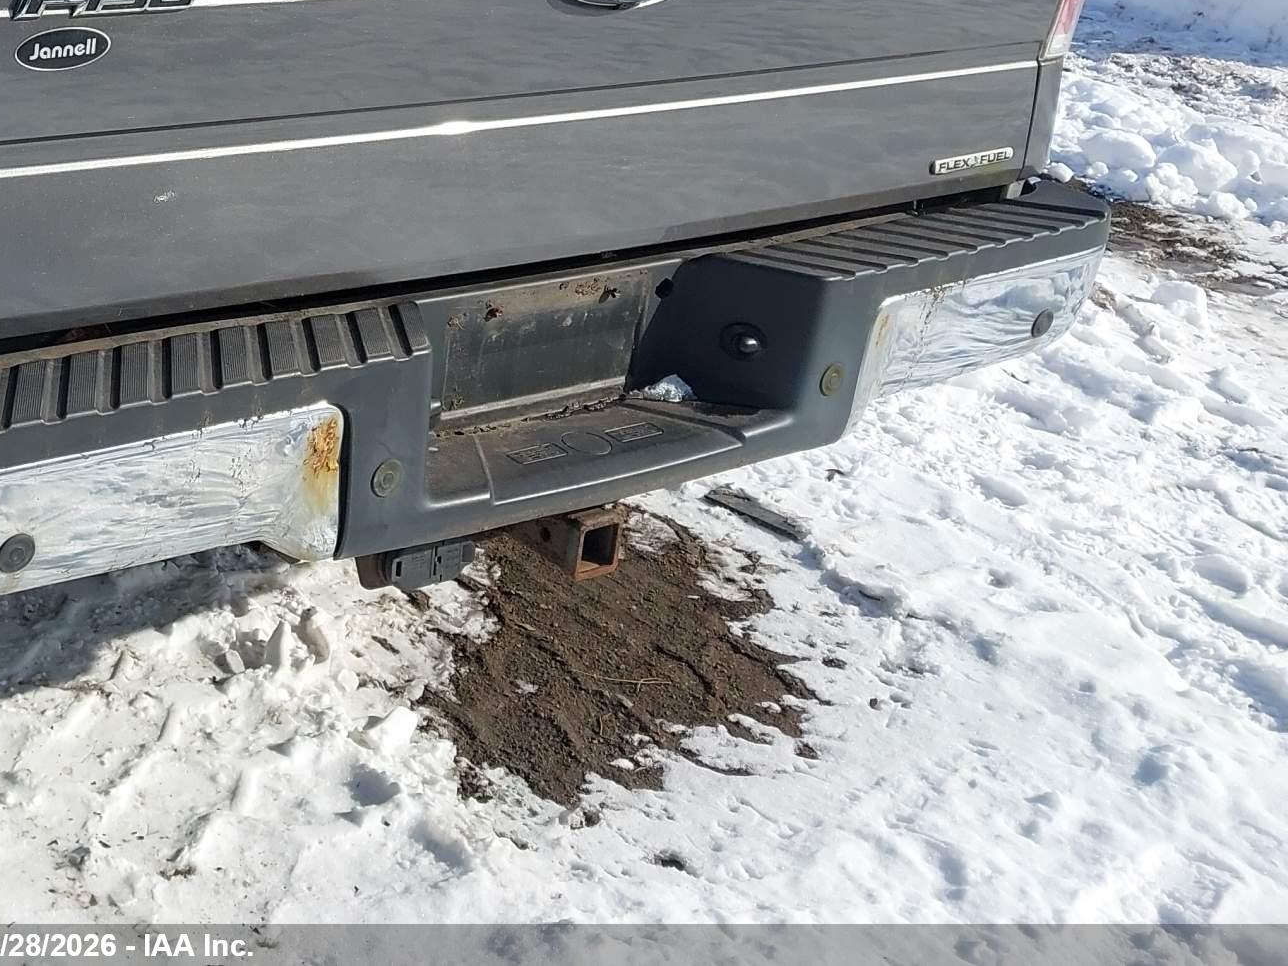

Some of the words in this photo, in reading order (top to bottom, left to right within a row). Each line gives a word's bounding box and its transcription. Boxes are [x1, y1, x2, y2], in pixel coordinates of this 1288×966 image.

[28, 37, 97, 61] Jannell
[938, 157, 970, 172] FLEX
[979, 150, 1011, 165] FUEL
